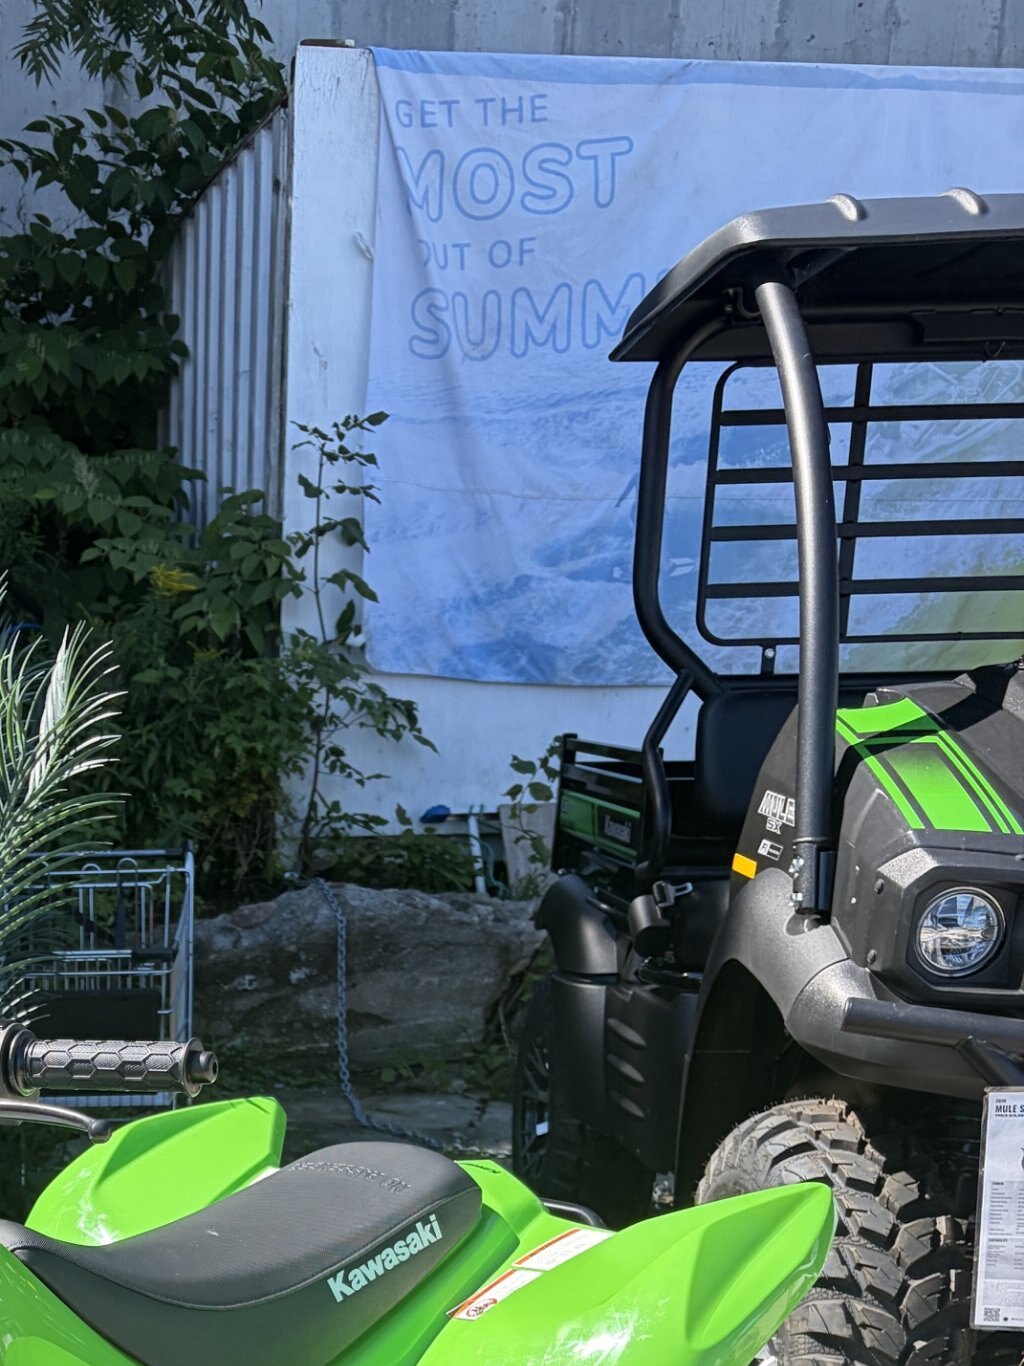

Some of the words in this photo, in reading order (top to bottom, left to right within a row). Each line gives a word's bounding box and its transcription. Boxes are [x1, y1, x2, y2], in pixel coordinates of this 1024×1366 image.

[395, 98, 460, 129] GET
[474, 93, 548, 127] THE
[395, 135, 634, 223] MOST
[488, 236, 536, 269] OF
[408, 268, 668, 361] SUMM
[757, 789, 796, 828] MULE
[995, 1104, 1017, 1113] MULE
[326, 1214, 444, 1303] Kawasaki
